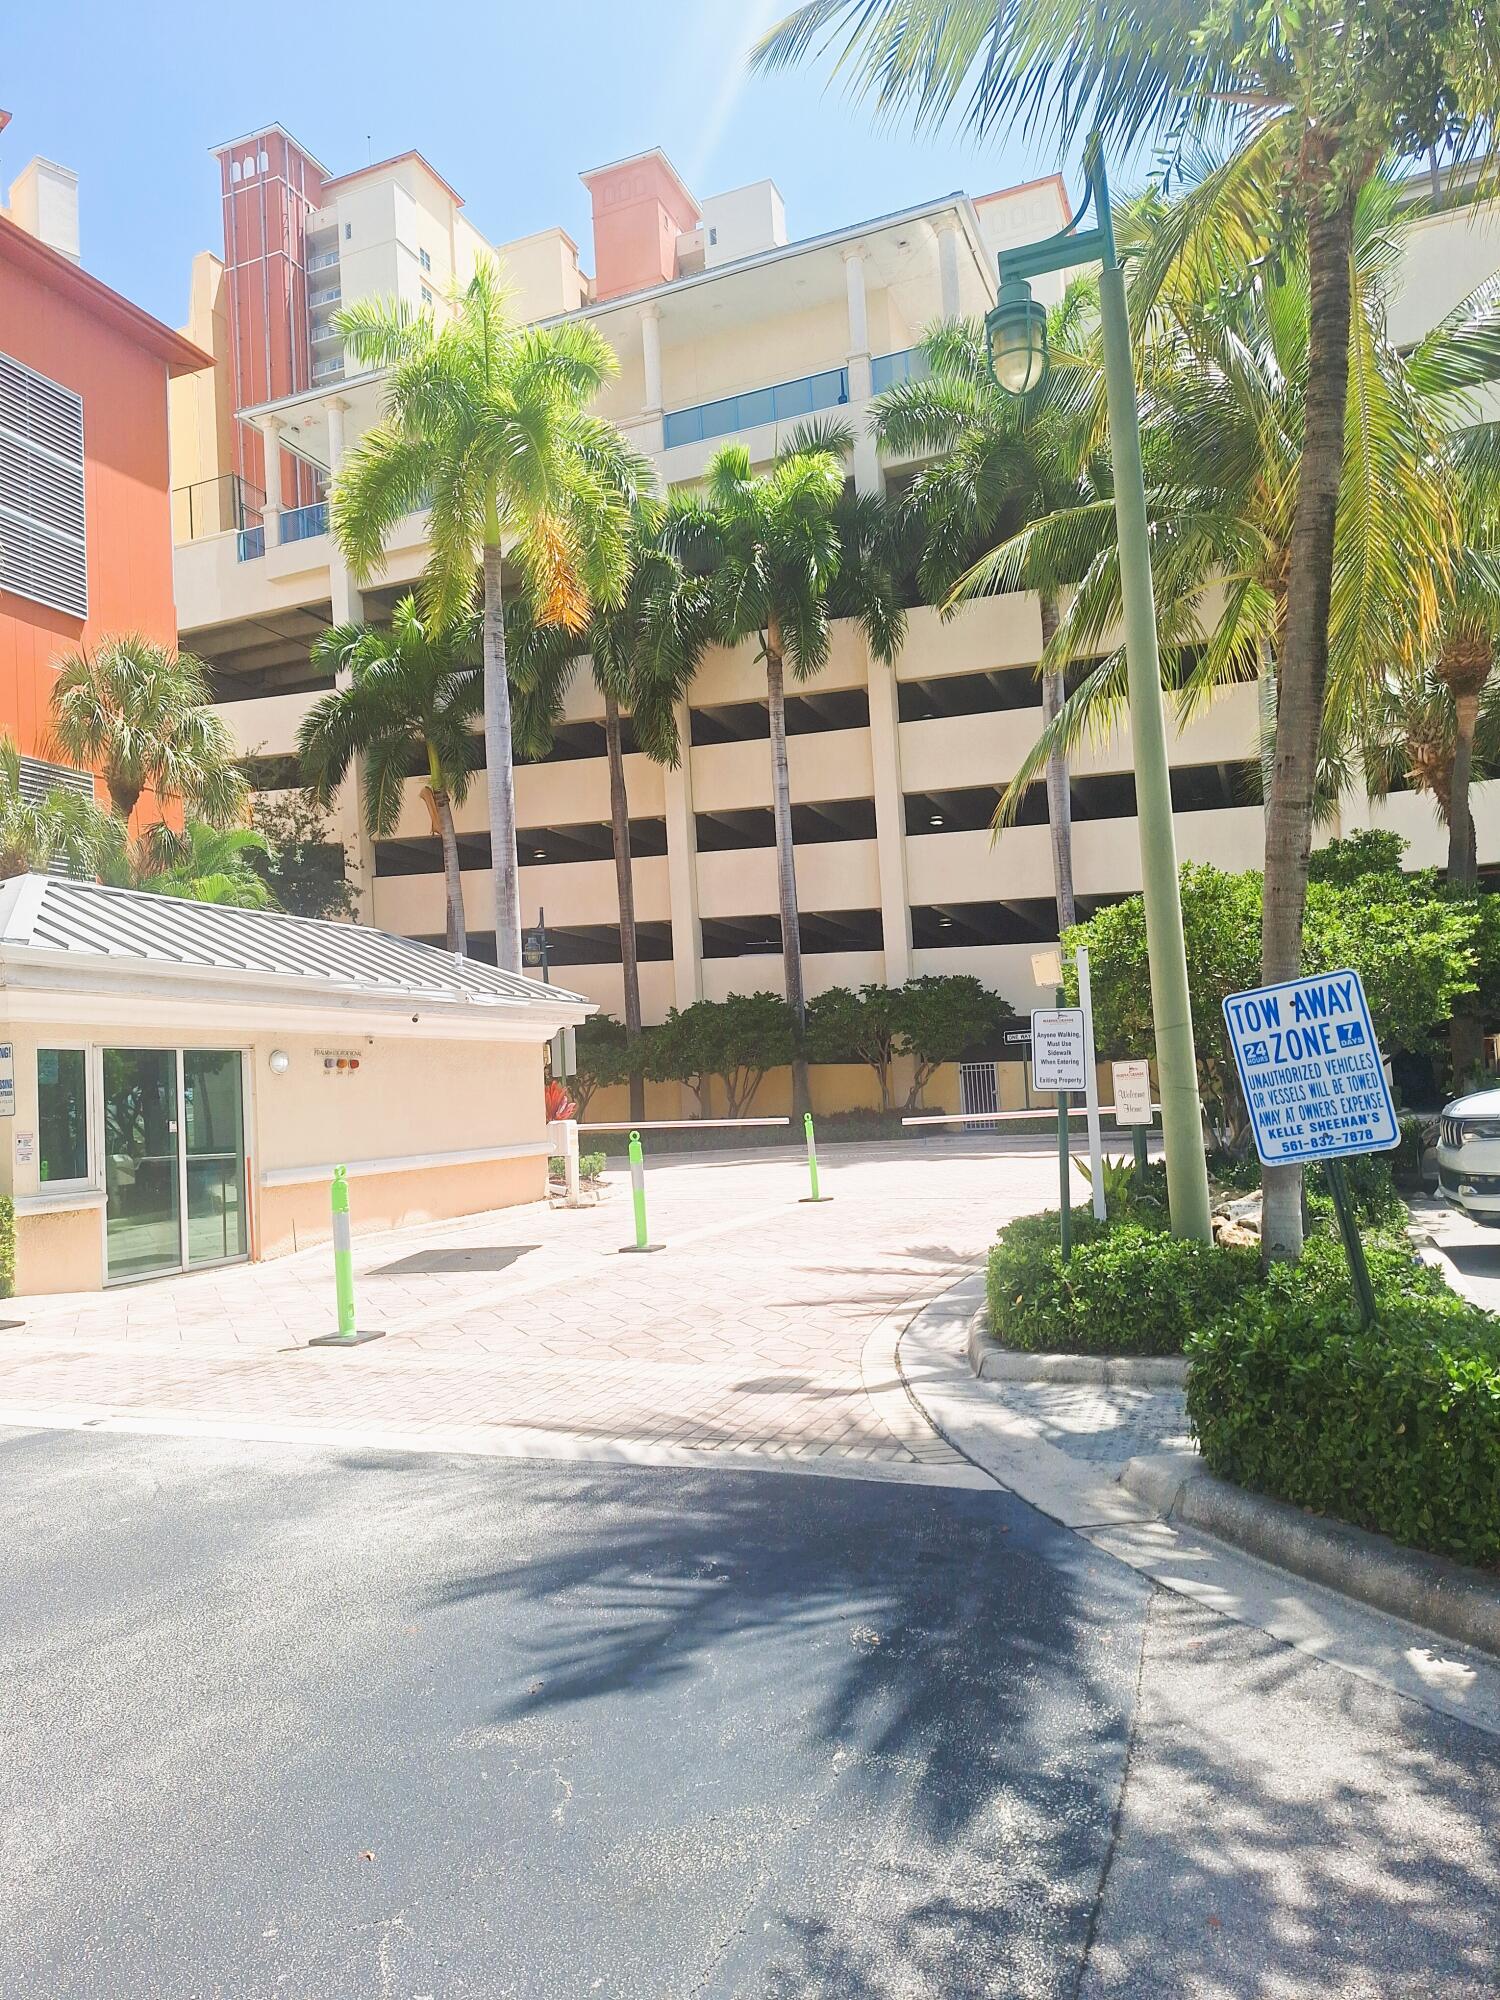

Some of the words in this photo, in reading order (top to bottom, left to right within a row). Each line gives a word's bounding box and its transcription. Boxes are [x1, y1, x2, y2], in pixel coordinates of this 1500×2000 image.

[1231, 997, 1280, 1034] TOW
[1294, 980, 1353, 1023] AWAY
[1037, 1032, 1057, 1040] Anyone
[1342, 1024, 1354, 1037] 7
[1245, 1044, 1267, 1058] 24
[1269, 1023, 1336, 1064] ZONE
[1341, 1037, 1364, 1047] DAYS
[1247, 1055, 1269, 1065] HOURS
[1058, 1077, 1082, 1085] Property
[1248, 1065, 1321, 1091] UNAUTHORIZED
[1325, 1053, 1374, 1076] VEHICLES
[1118, 1089, 1145, 1099] Welcome
[1252, 1093, 1265, 1109] OR
[1268, 1086, 1305, 1106] VESSELS
[1308, 1080, 1330, 1098] WILL
[1333, 1078, 1345, 1094] BE
[1347, 1072, 1379, 1091] TOWED
[1258, 1110, 1281, 1128] AWAY
[1285, 1106, 1295, 1122] AT
[1299, 1100, 1338, 1121] OWNERS
[1341, 1092, 1384, 1114] EXPENSE
[1268, 1124, 1304, 1140] KELLE
[1310, 1112, 1380, 1133] SHEEHAN'S
[1282, 1129, 1374, 1152] 561-832-7878
